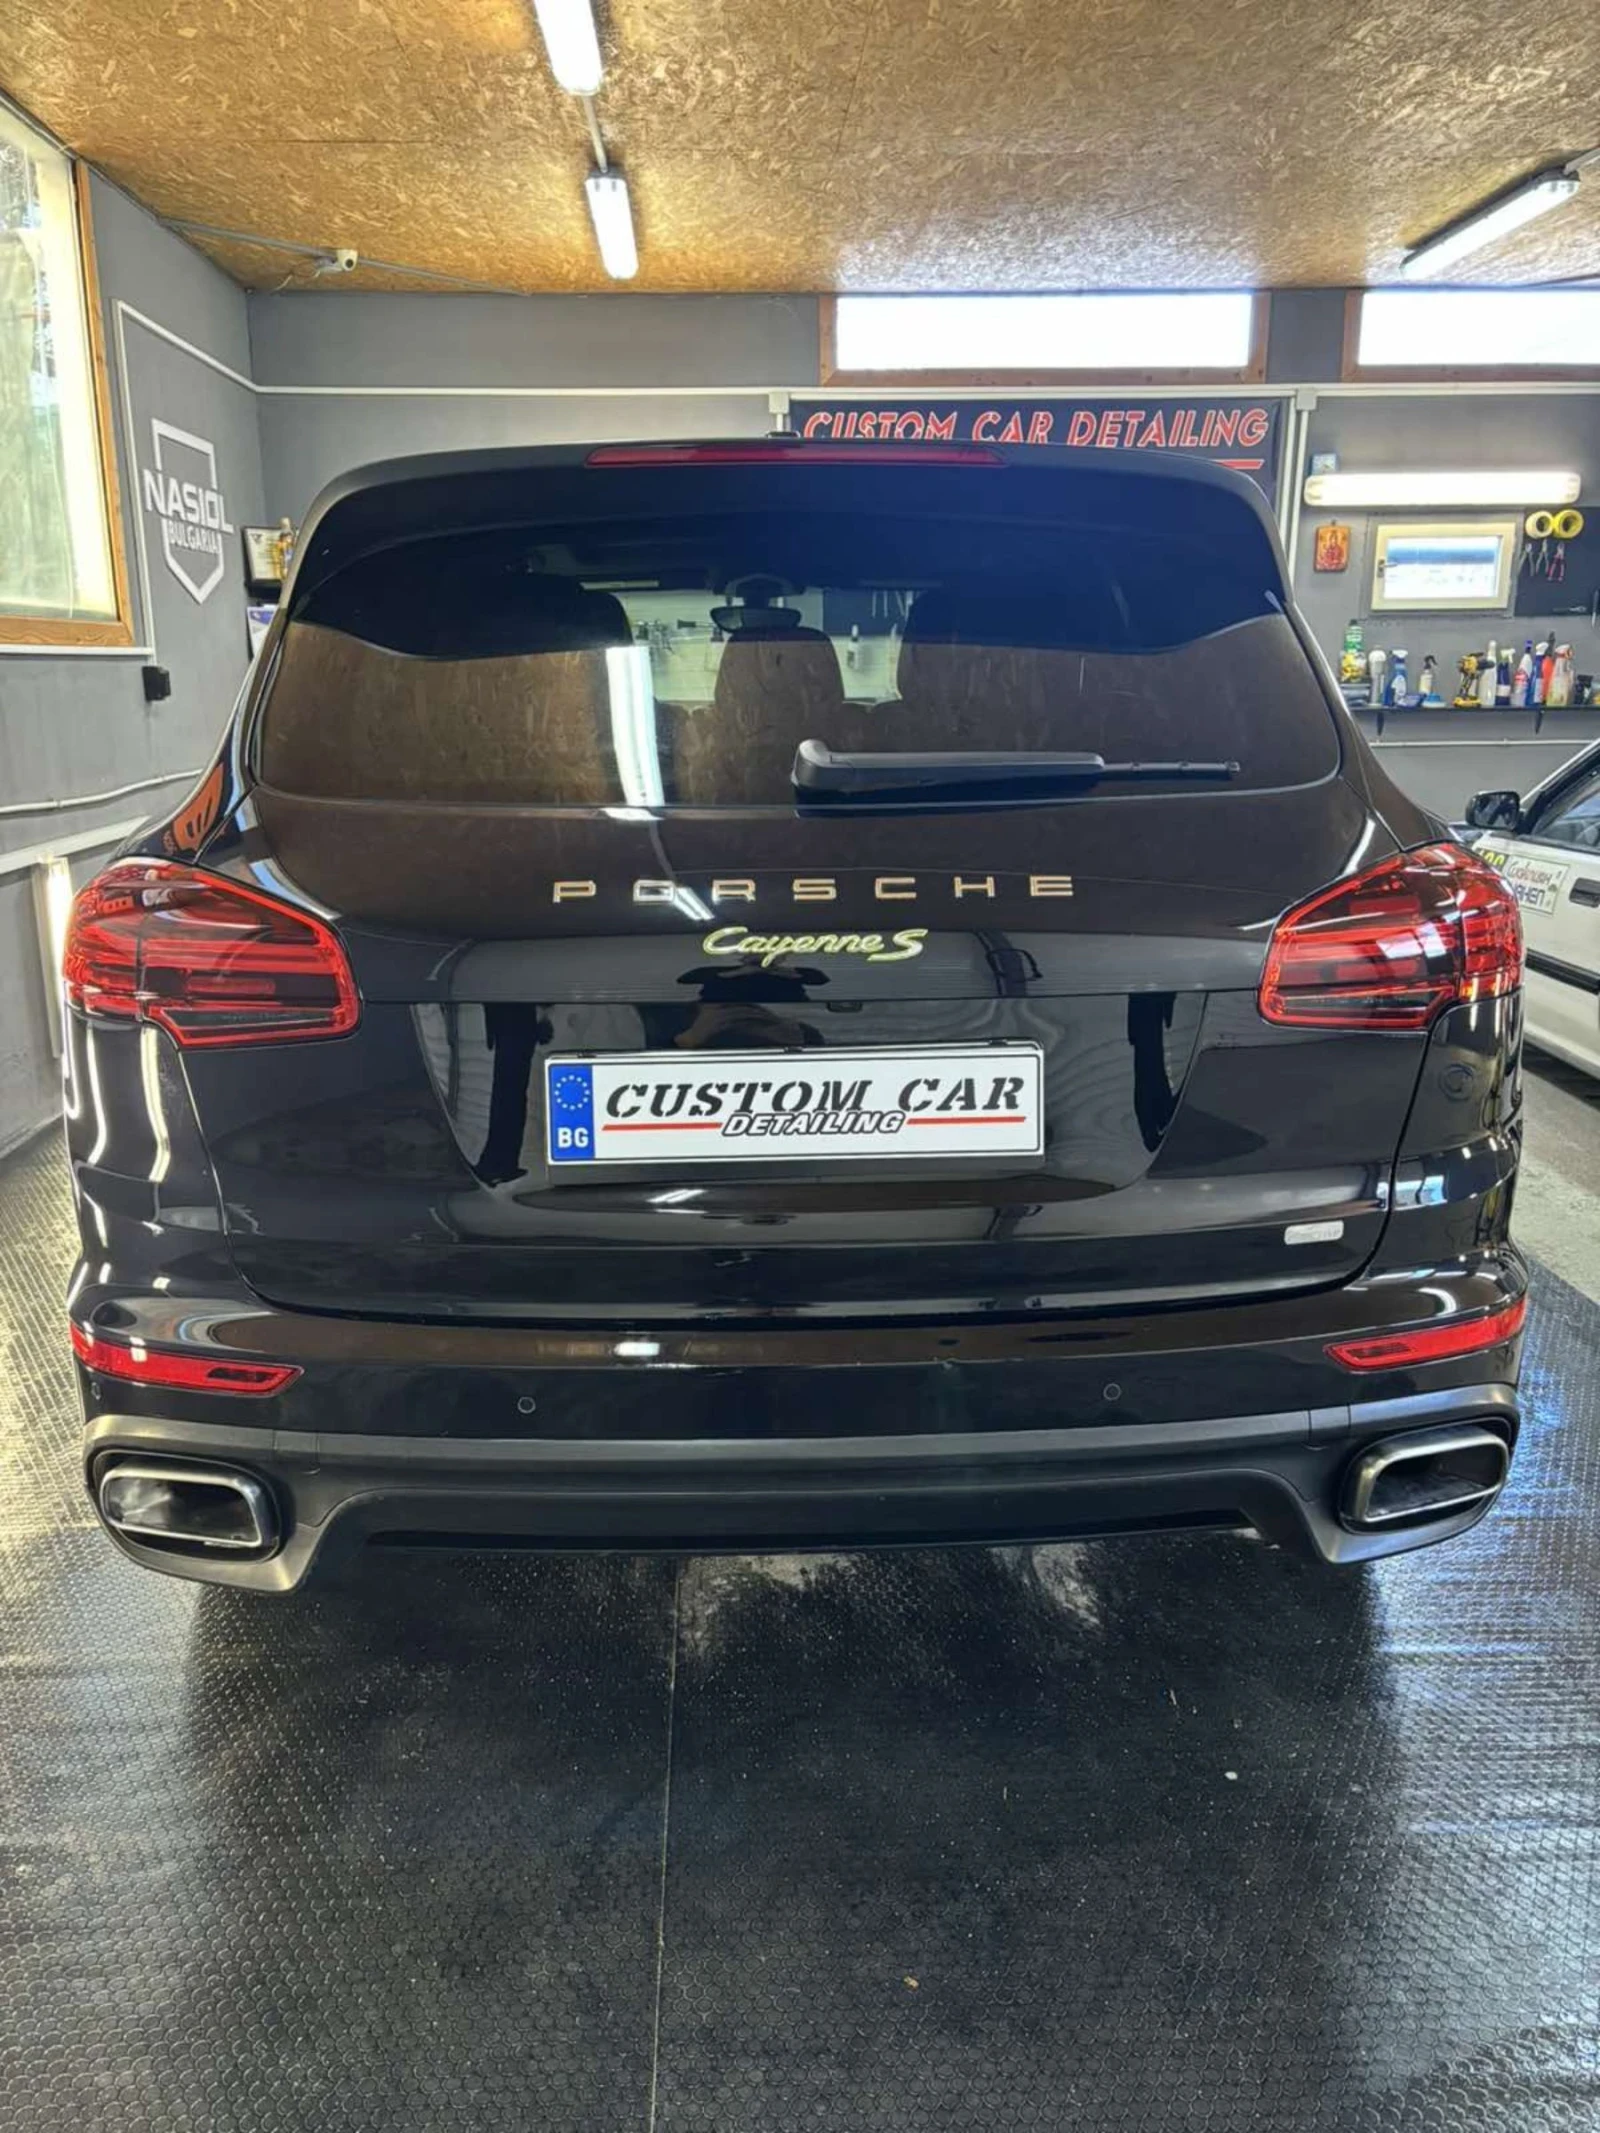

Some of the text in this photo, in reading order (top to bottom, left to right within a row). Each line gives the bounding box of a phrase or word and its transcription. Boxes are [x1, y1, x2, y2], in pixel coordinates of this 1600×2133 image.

[804, 408, 1269, 447] CUSTOM CAR DETAILING
[143, 468, 234, 533] NASIOL
[168, 520, 220, 554] BULGARIA
[554, 875, 1074, 903] PORSCHE
[702, 926, 929, 968] Cayenne S
[606, 1077, 1025, 1118] CUSTOM CAR
[557, 1127, 589, 1148] BG
[722, 1110, 906, 1137] DETAILING
